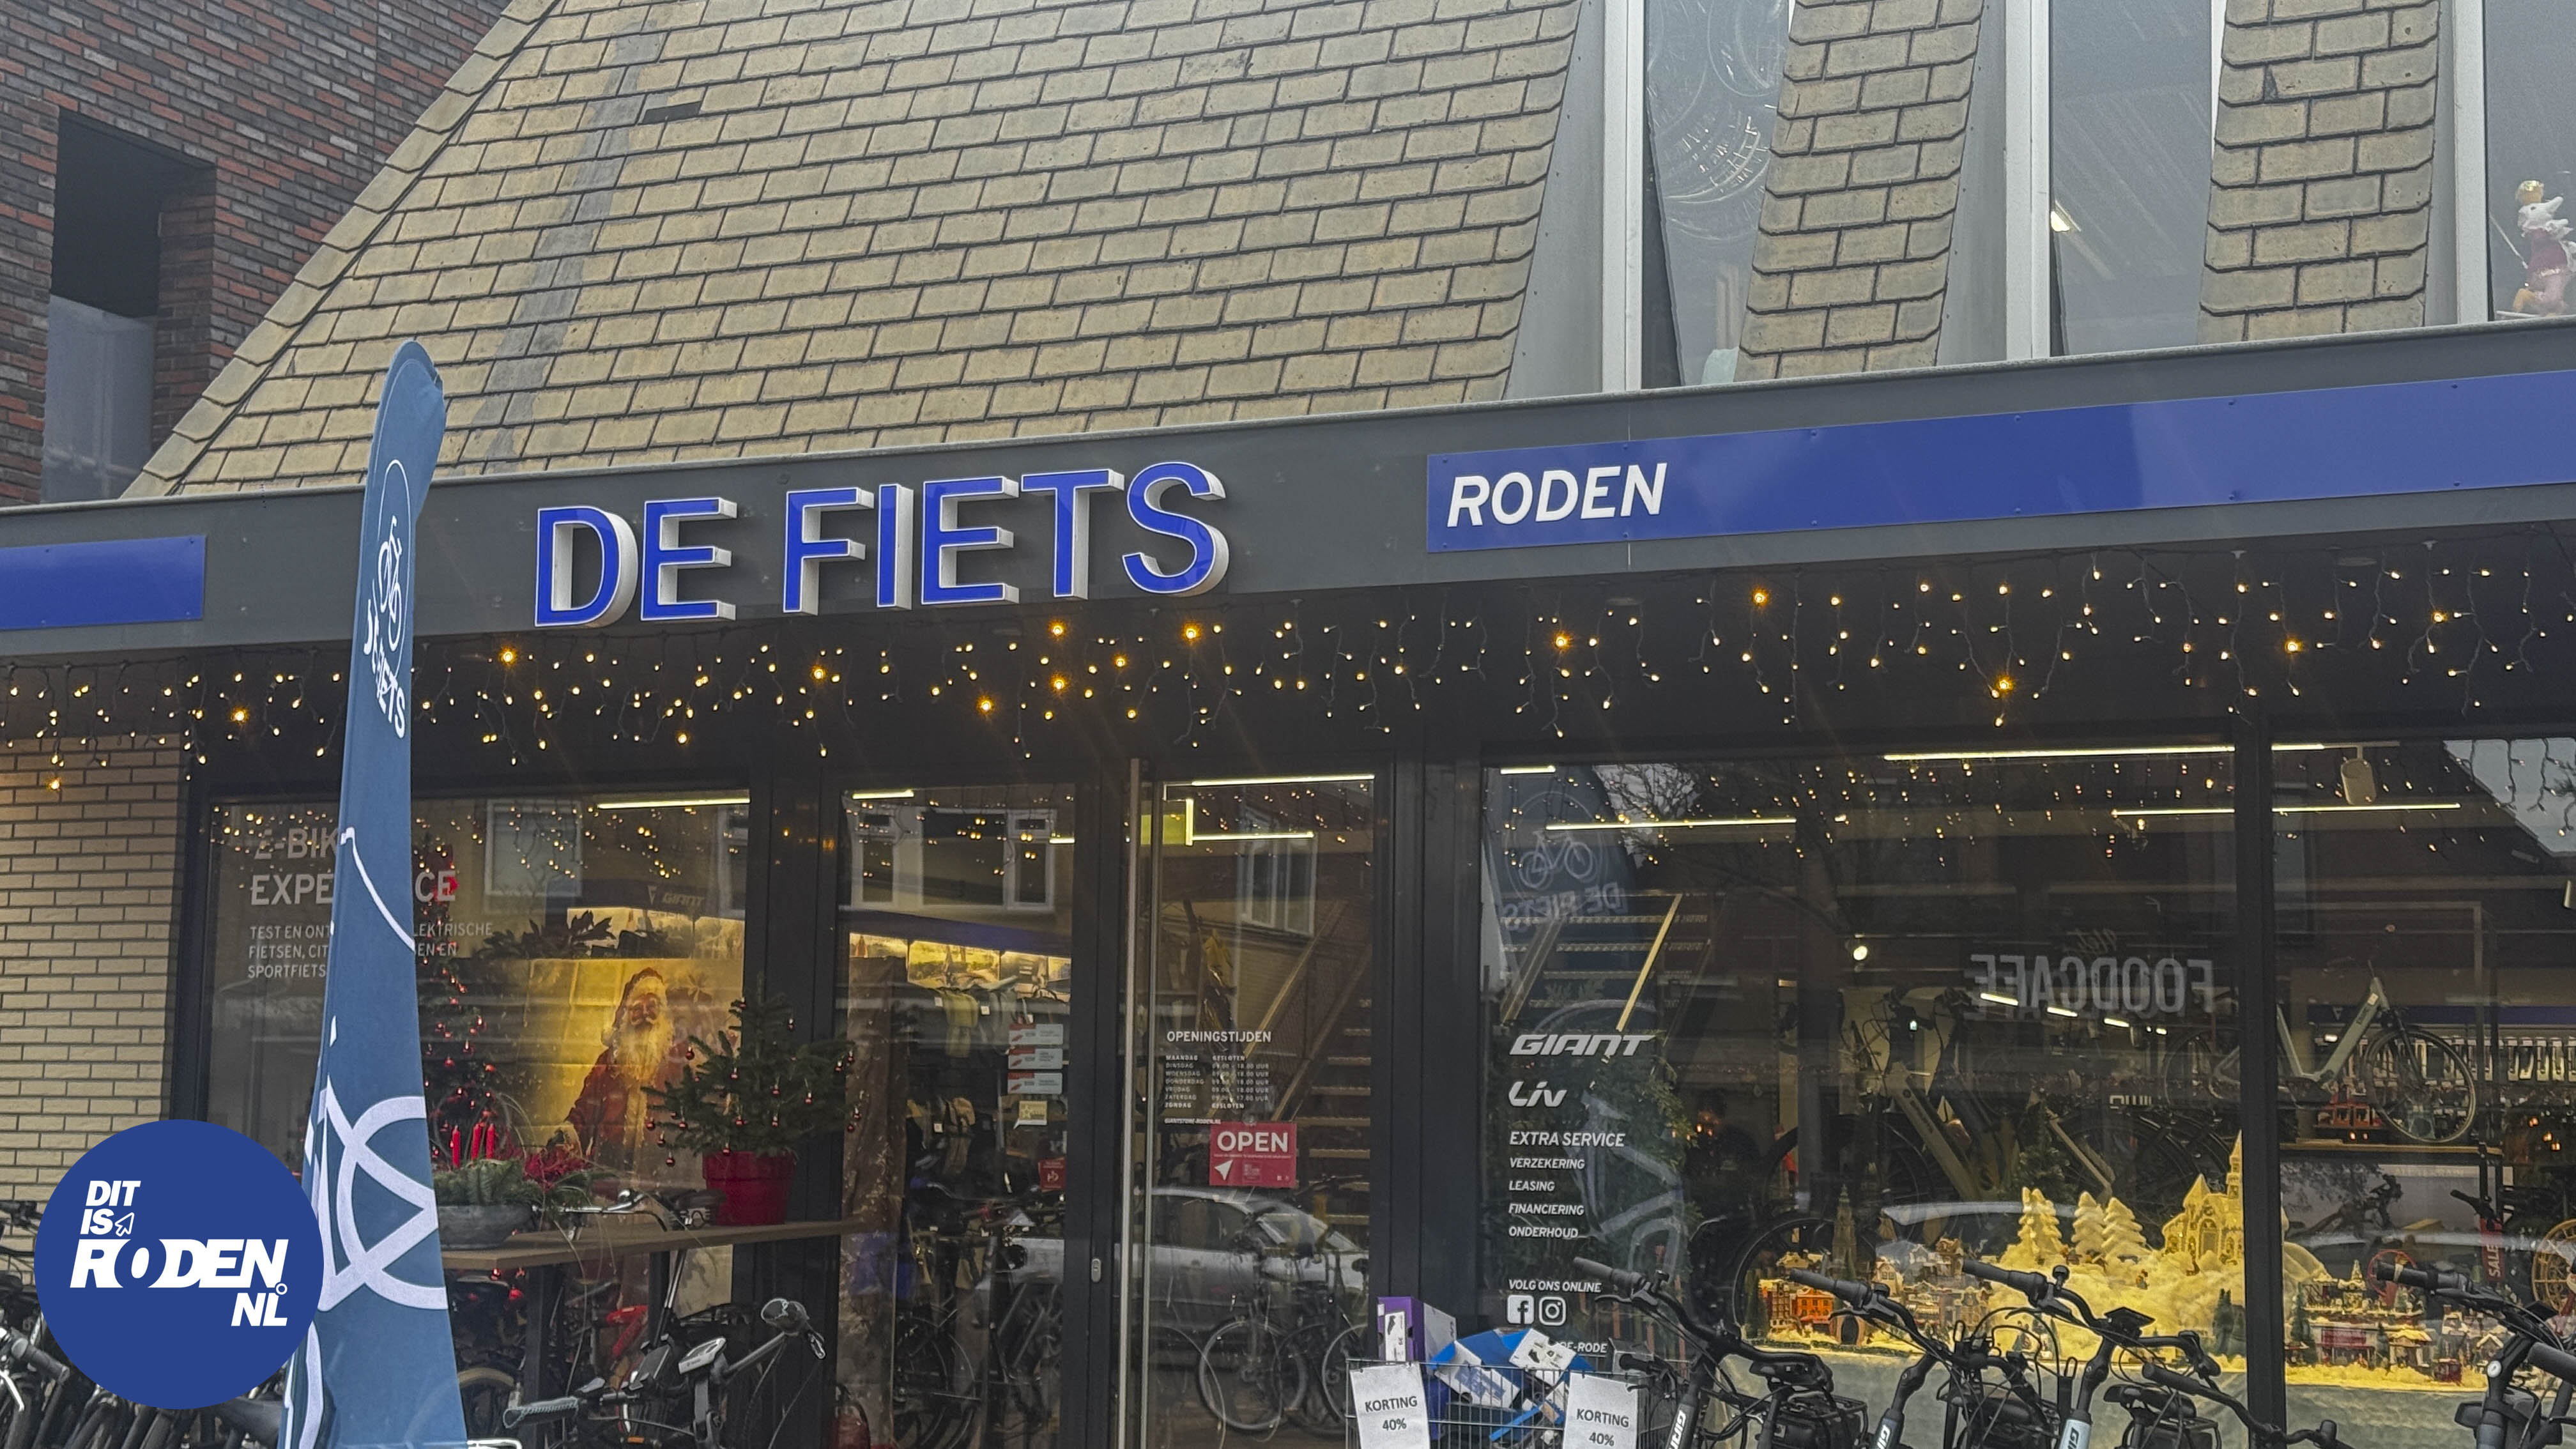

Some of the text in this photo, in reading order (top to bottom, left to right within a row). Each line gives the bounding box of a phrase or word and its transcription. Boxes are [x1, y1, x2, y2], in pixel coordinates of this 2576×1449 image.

[1447, 462, 1667, 528] RODEN
[534, 460, 1230, 628] DE FIETS
[254, 827, 339, 859] E-BIK
[250, 926, 281, 939] TEST
[284, 925, 301, 939] EN
[249, 945, 305, 959] FIETSEN,
[247, 965, 326, 979] SPORTFIETS
[1167, 1031, 1271, 1043] OPENINGSTIJDEN
[1509, 1034, 1656, 1056] GIANT
[1508, 1081, 1567, 1107] Liv
[1217, 1131, 1289, 1153] OPEN
[1510, 1131, 1626, 1147] EXTRA SERVICE
[1510, 1158, 1585, 1169] VERZEKERING
[1508, 1181, 1555, 1192] LEASING
[1508, 1203, 1584, 1215] FINANCIERING
[1508, 1227, 1579, 1238] ONDERHOUD
[2486, 1244, 2501, 1277] SALE
[1508, 1279, 1602, 1293] VOLG ONS ONLINE
[1365, 1395, 1418, 1413] KORTING
[1383, 1418, 1407, 1431] 40%
[1576, 1408, 1629, 1428] KORTING
[1589, 1432, 1615, 1447] 40%
